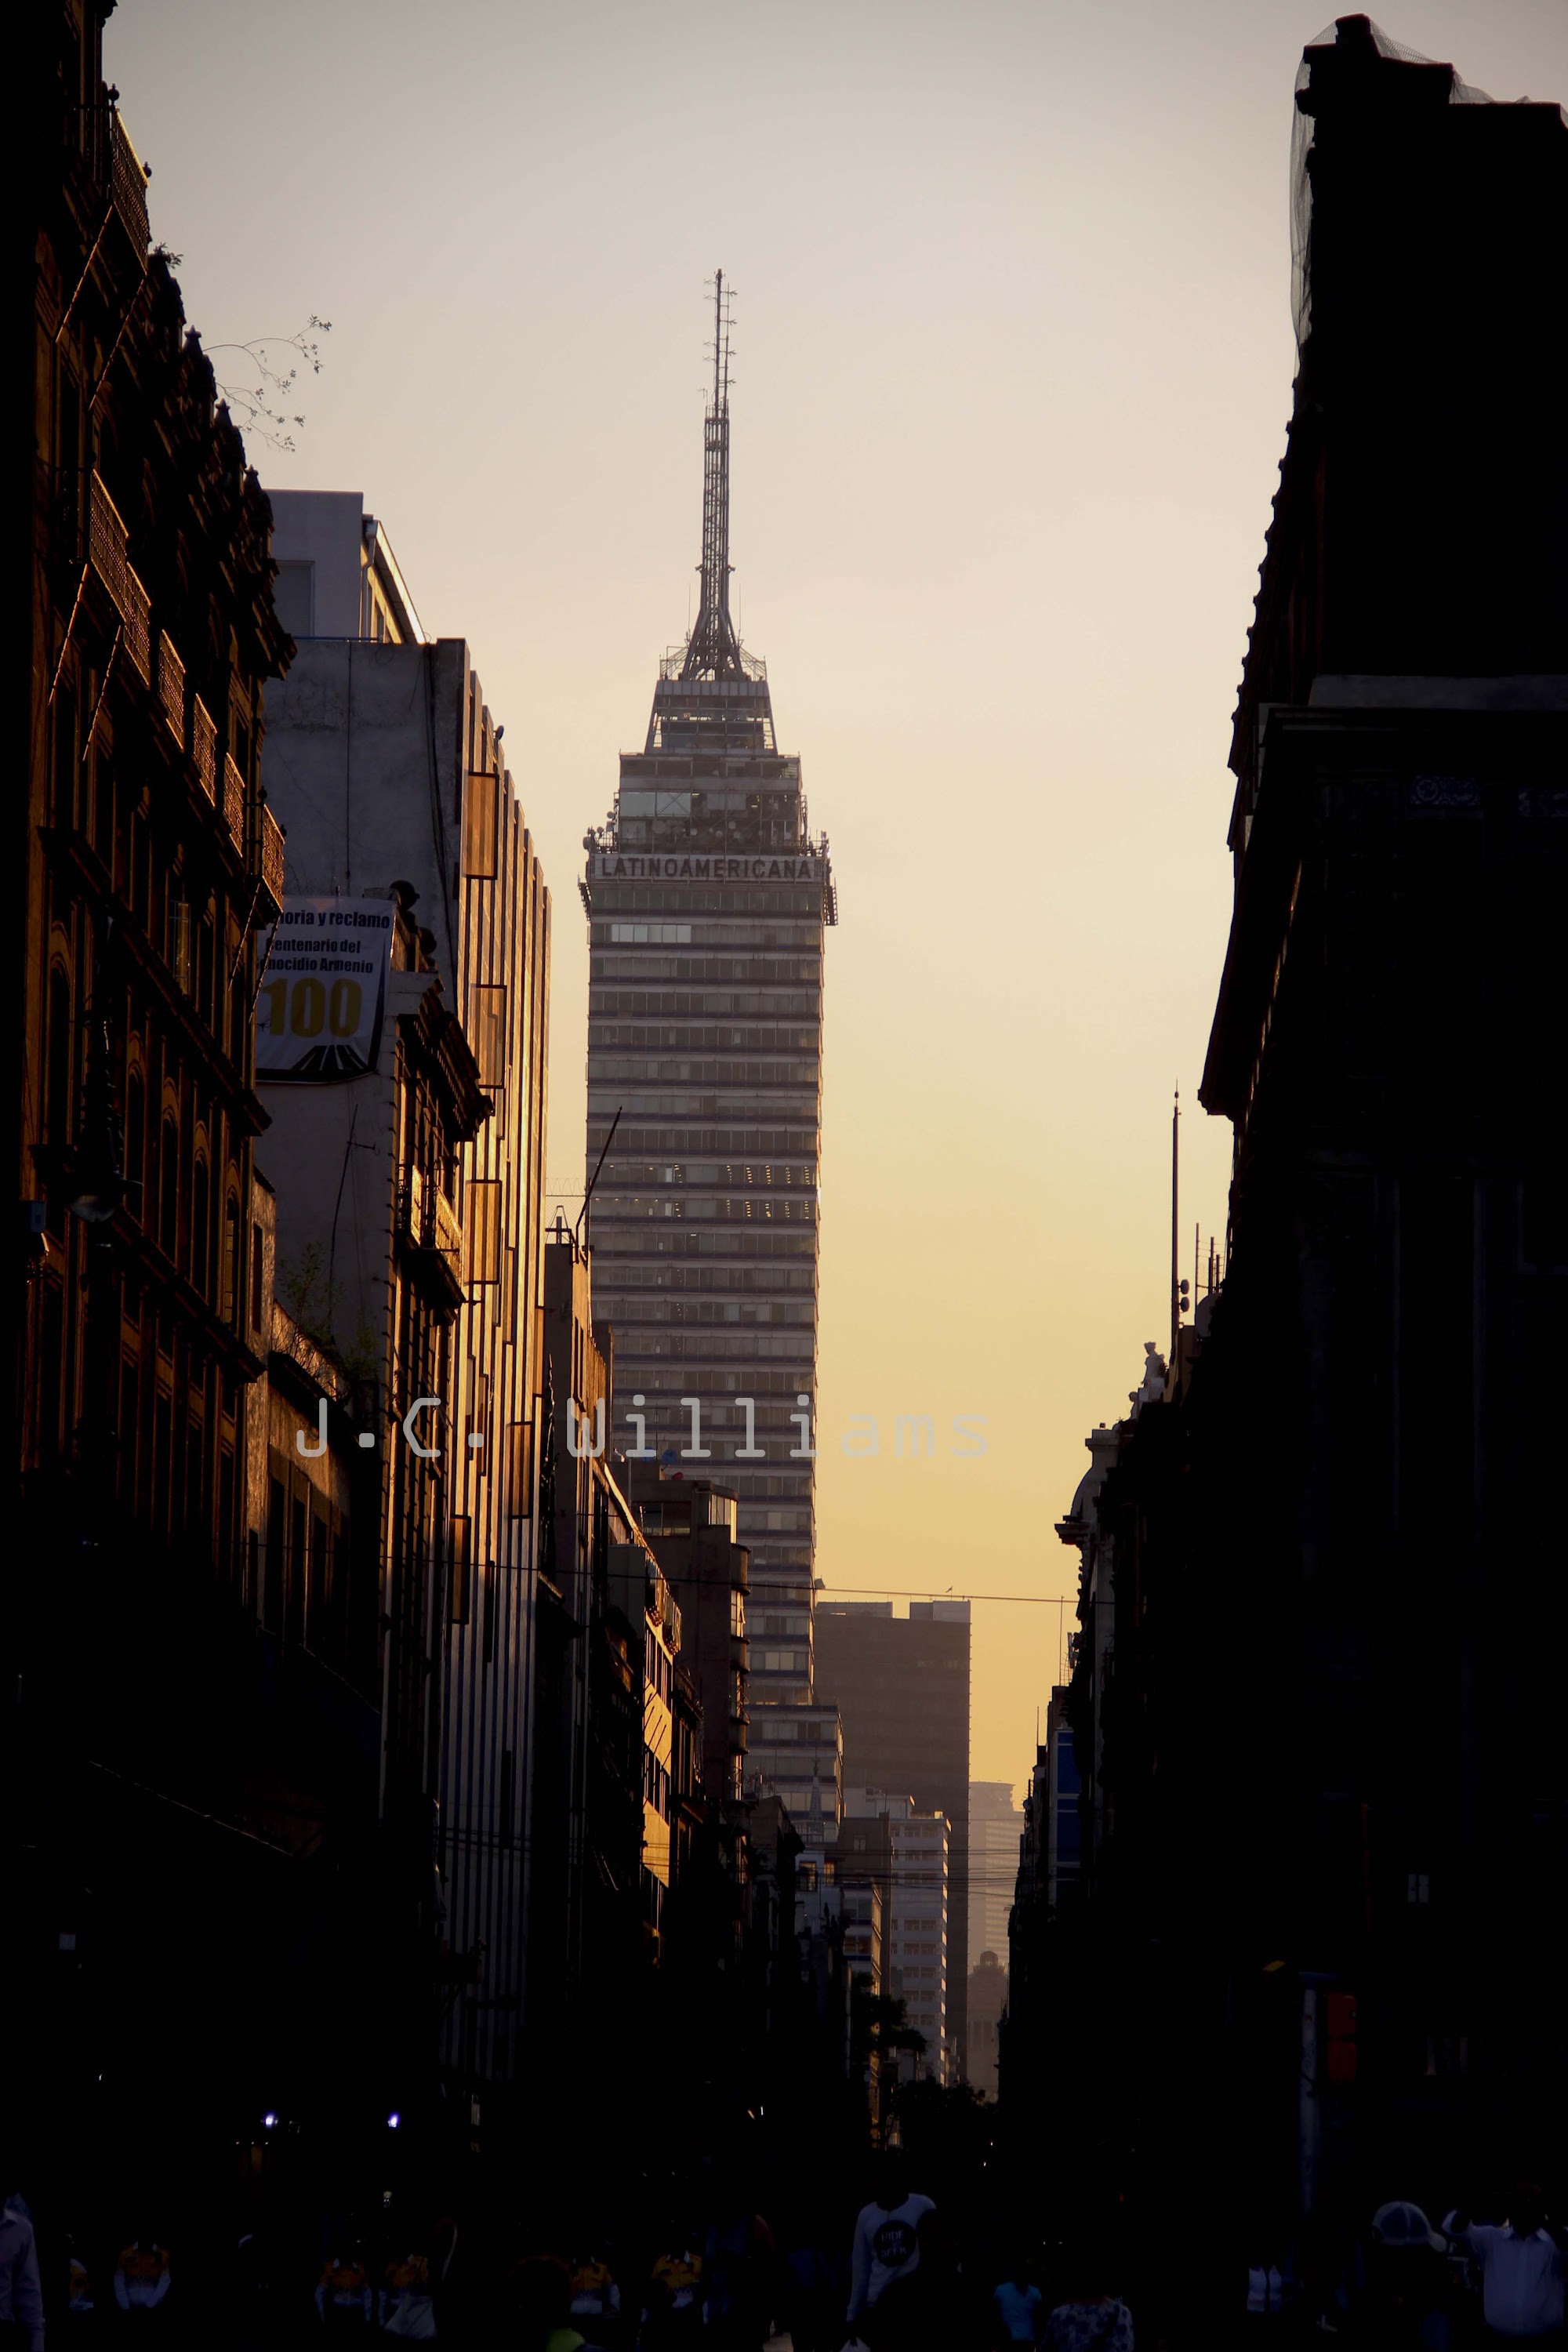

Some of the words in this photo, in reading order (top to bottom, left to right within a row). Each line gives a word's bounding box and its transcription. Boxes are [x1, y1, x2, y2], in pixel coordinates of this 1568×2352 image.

[601, 857, 812, 878] LATINOAMERICANA
[280, 910, 314, 925] oria
[318, 913, 326, 927] y
[329, 912, 390, 929] reclamo
[271, 938, 338, 953] entenario
[339, 940, 361, 953] del
[319, 958, 373, 974] Armenio
[262, 978, 362, 1038] 100
